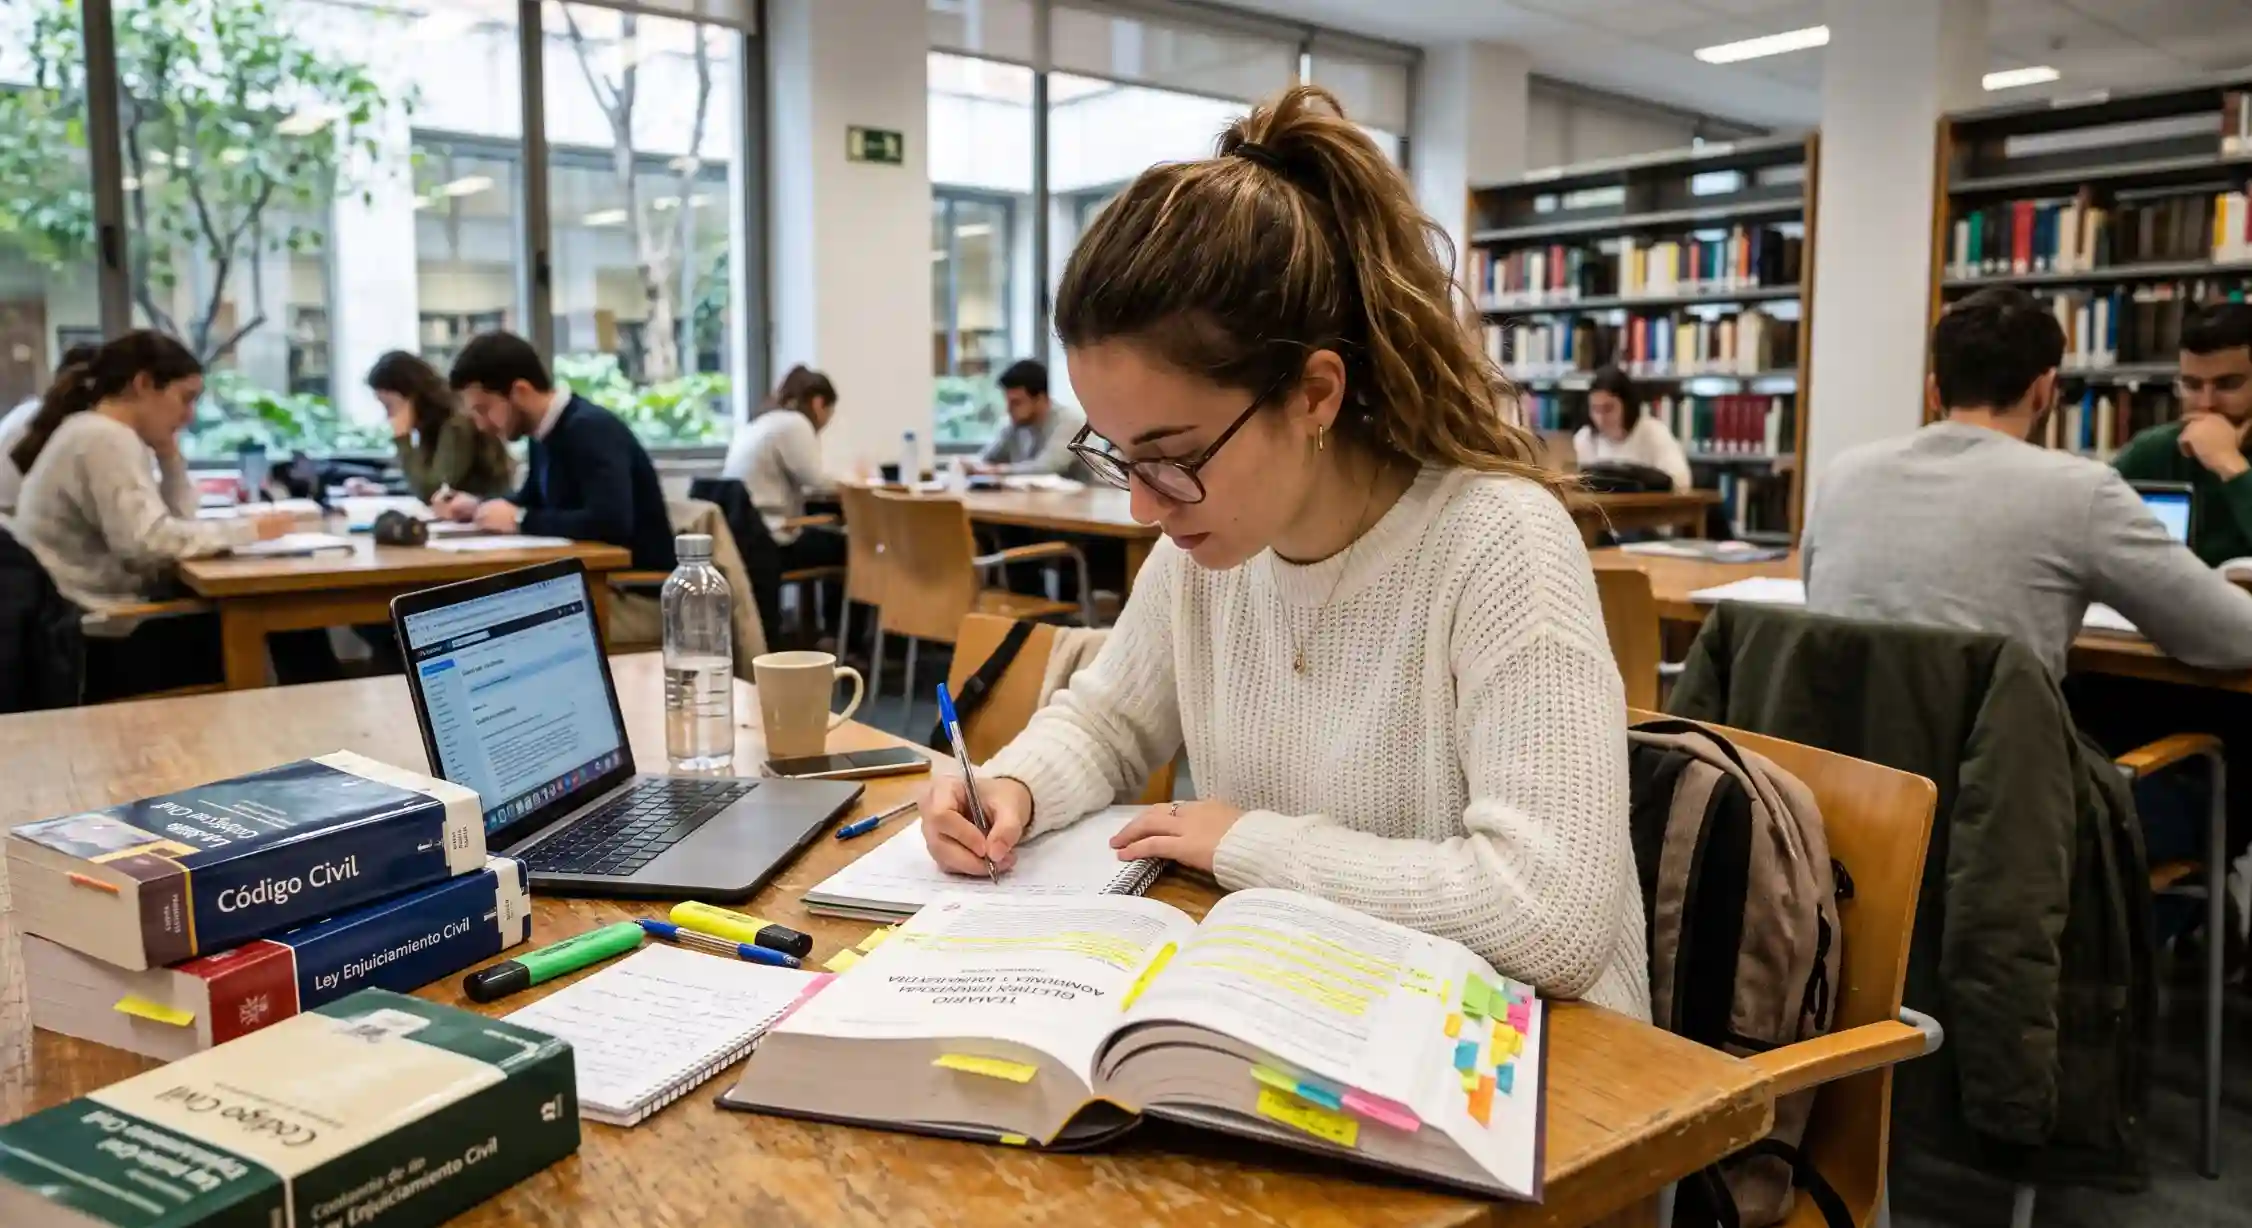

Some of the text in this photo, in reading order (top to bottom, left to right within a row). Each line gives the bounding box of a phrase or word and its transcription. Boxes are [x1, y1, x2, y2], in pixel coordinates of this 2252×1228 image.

[217, 873, 303, 913] Código
[309, 854, 360, 889] Civil
[314, 916, 470, 991] Ley Enjuiciamiento Civil
[464, 1136, 498, 1164] Civil
